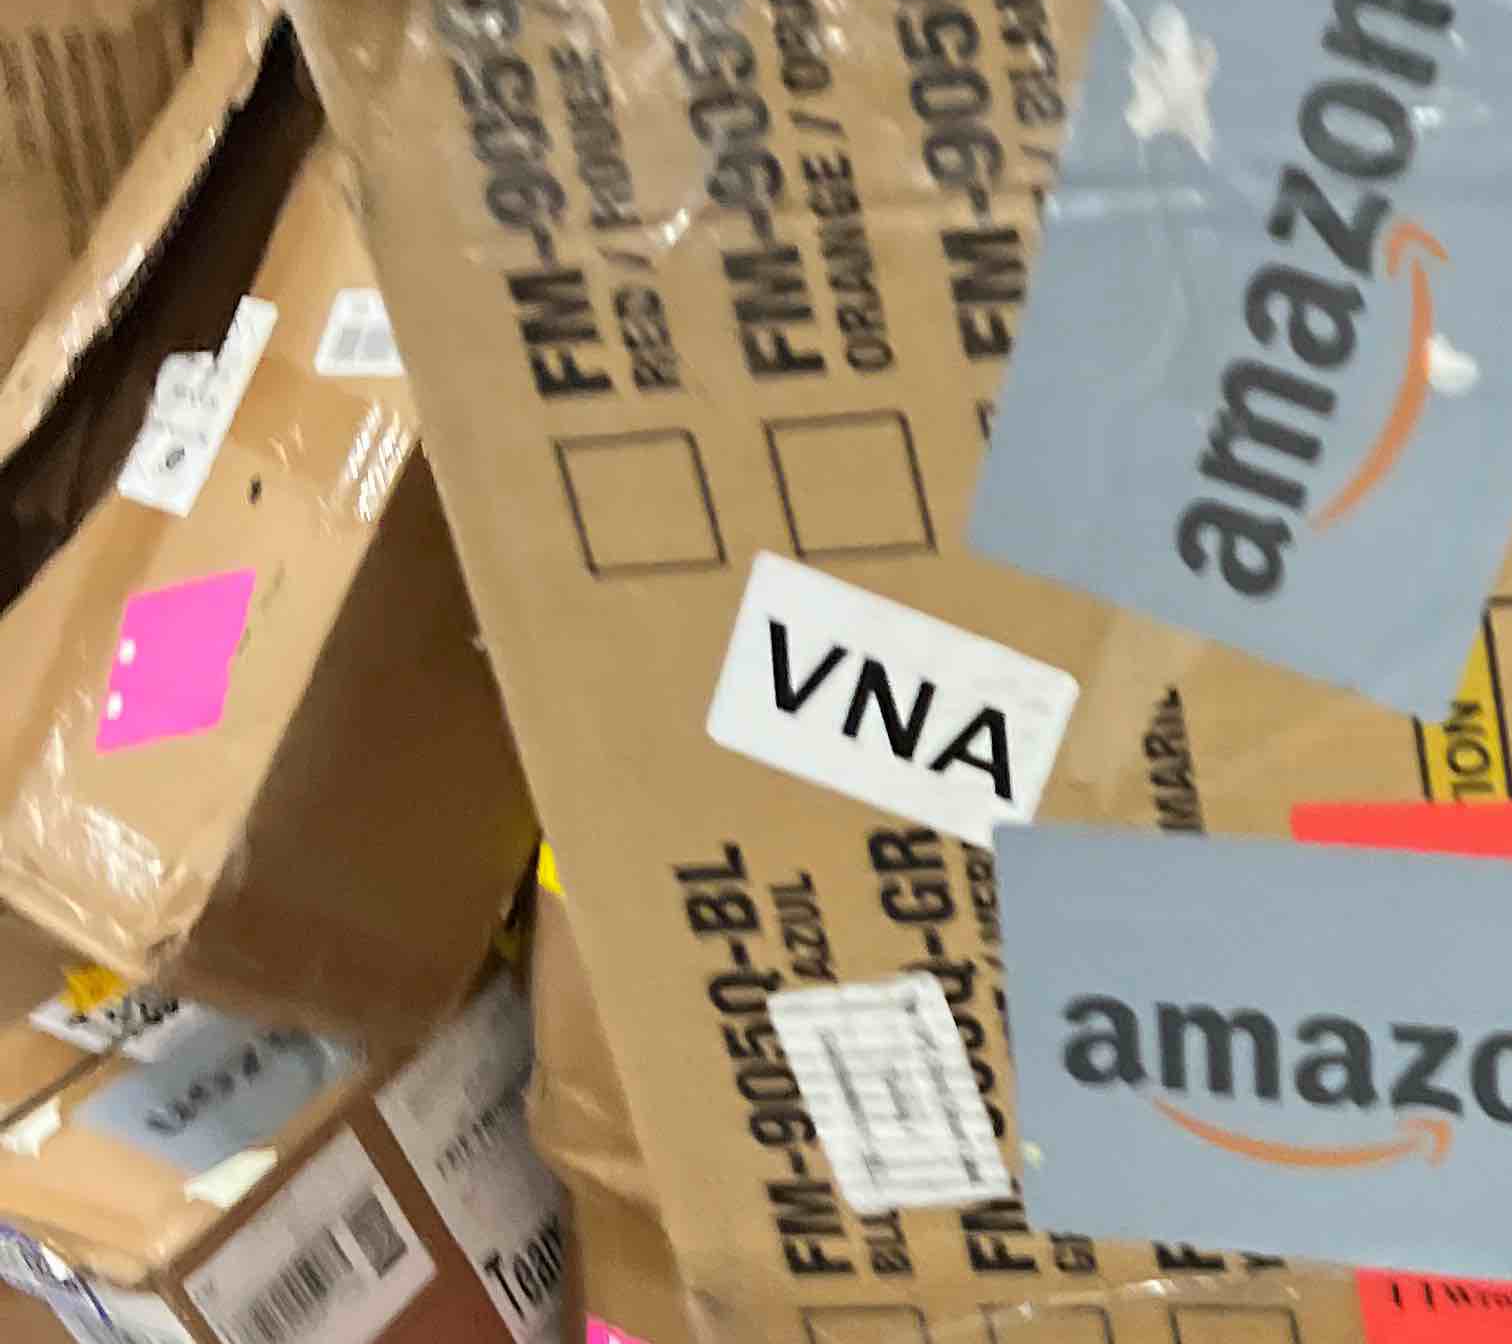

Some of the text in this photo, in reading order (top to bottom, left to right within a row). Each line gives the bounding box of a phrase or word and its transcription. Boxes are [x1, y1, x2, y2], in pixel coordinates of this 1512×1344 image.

[801, 151, 896, 376] ORANGE
[768, 617, 1014, 803] VNA
[1442, 700, 1494, 798] ION
[769, 867, 840, 986] AZUL
